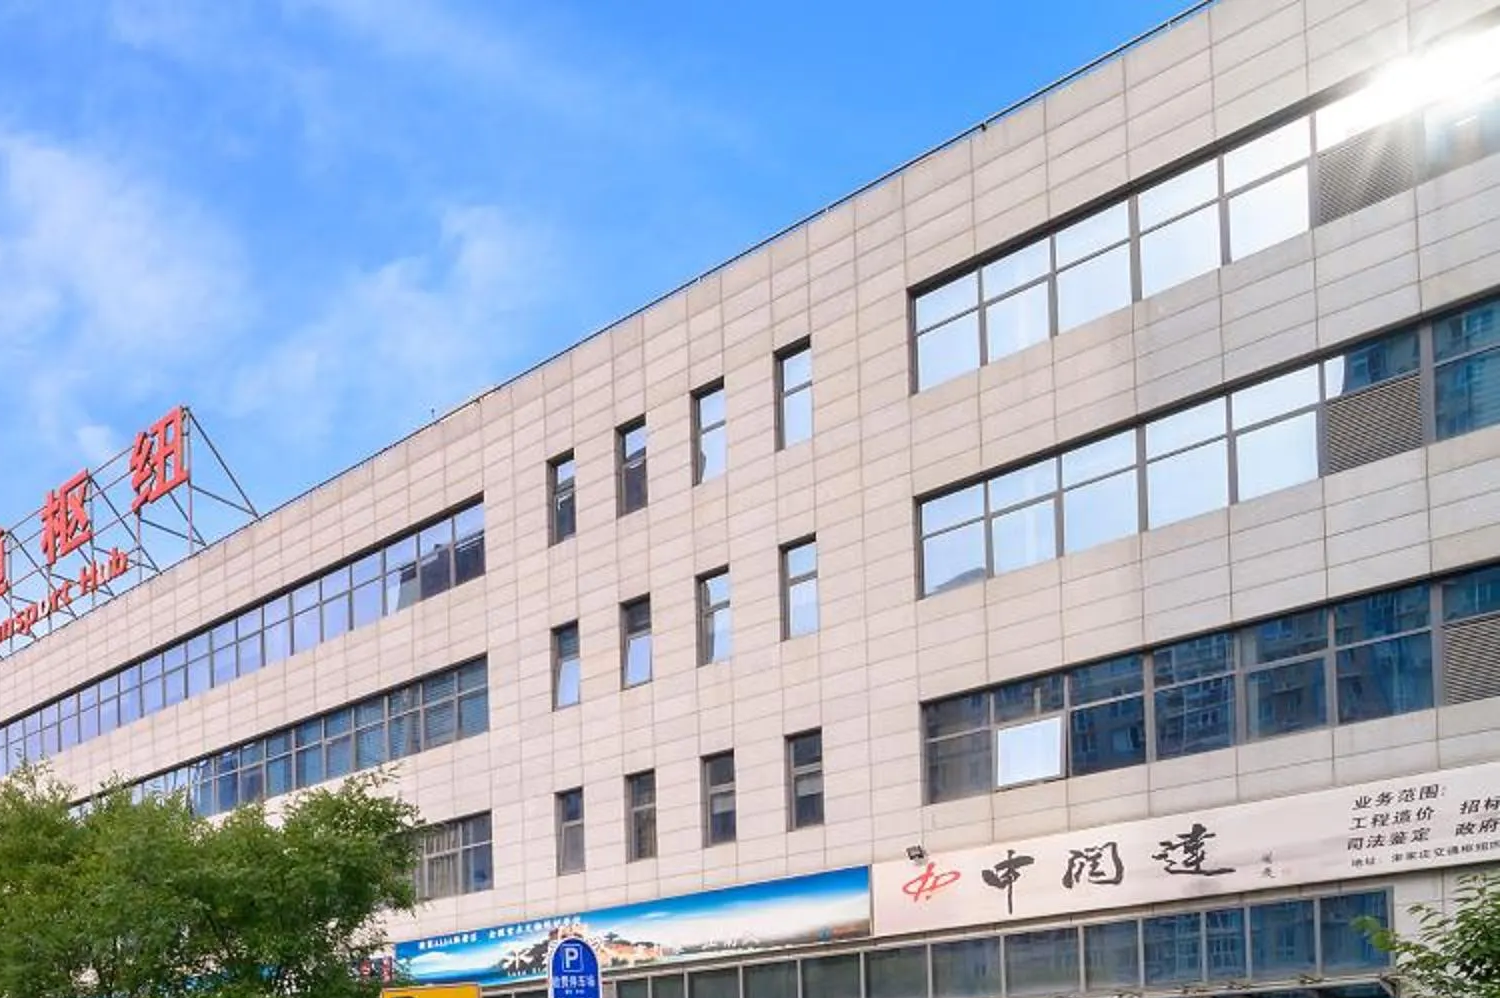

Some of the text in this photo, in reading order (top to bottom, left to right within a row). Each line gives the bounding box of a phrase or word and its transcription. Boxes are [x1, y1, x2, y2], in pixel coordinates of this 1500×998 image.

[79, 546, 130, 597] Hub
[1348, 805, 1435, 831] 工程造价
[1347, 827, 1432, 851] 司法鉴定
[563, 947, 579, 969] P
